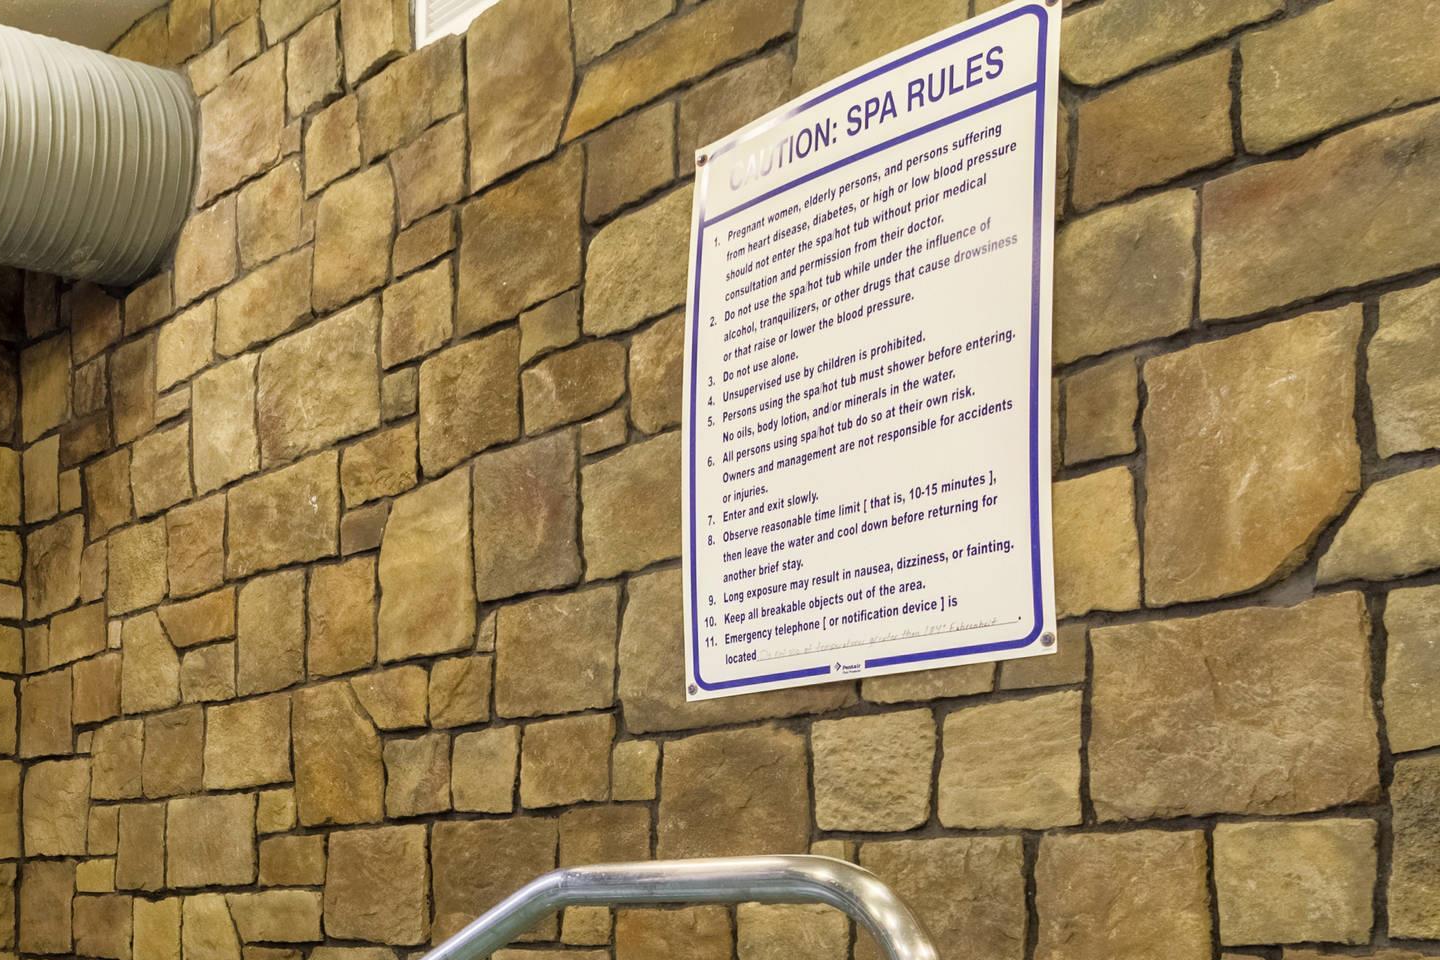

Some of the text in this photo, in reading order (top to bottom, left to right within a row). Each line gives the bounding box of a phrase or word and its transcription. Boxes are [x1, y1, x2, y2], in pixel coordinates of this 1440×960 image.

[846, 90, 898, 136] SPA
[908, 46, 1004, 112] RULES
[726, 142, 1016, 261] from heart disease, diabetes, high low blood pressure
[728, 123, 1001, 241] Pregnant women, elderly persons, and persons suffering
[724, 214, 943, 301] consultation and permission from their doctor.
[725, 172, 986, 281] should not enter the tub without prior medical
[723, 234, 1018, 342] alcohol, tranquilizers, other drugs that cause drowsiness
[724, 225, 976, 321] Do not use the tub while under the influence
[734, 292, 914, 358] that raise lower the blood pressure.
[722, 330, 925, 402] Unsupervised use children is prohibited.
[722, 351, 798, 382] Do not use alone.
[722, 329, 1015, 422] Persons using the tub must shower before entering.
[722, 369, 955, 443] No oils, body lotion, minerals in the water.
[722, 385, 974, 463] All persons using tub their own risk.
[722, 399, 1012, 483] Owners and management are not responsible for accidents
[722, 490, 818, 522] Enter and exit slowly.
[722, 474, 985, 542] Observe reasonable time limit that is, 10-15 minutes
[723, 494, 998, 562] then leave the water and cool down before returning for
[733, 485, 768, 502] injuries.
[723, 558, 803, 583] another brief stay.
[723, 539, 1014, 603] Long exposure may result in nausea, dizziness, fainting.
[724, 580, 925, 624] Keep all breakable objects out the area.
[724, 628, 772, 644] Emergency
[774, 620, 820, 636] telephone
[841, 605, 898, 624] notification
[902, 599, 937, 614] device
[948, 595, 957, 607] is
[725, 648, 756, 664] located
